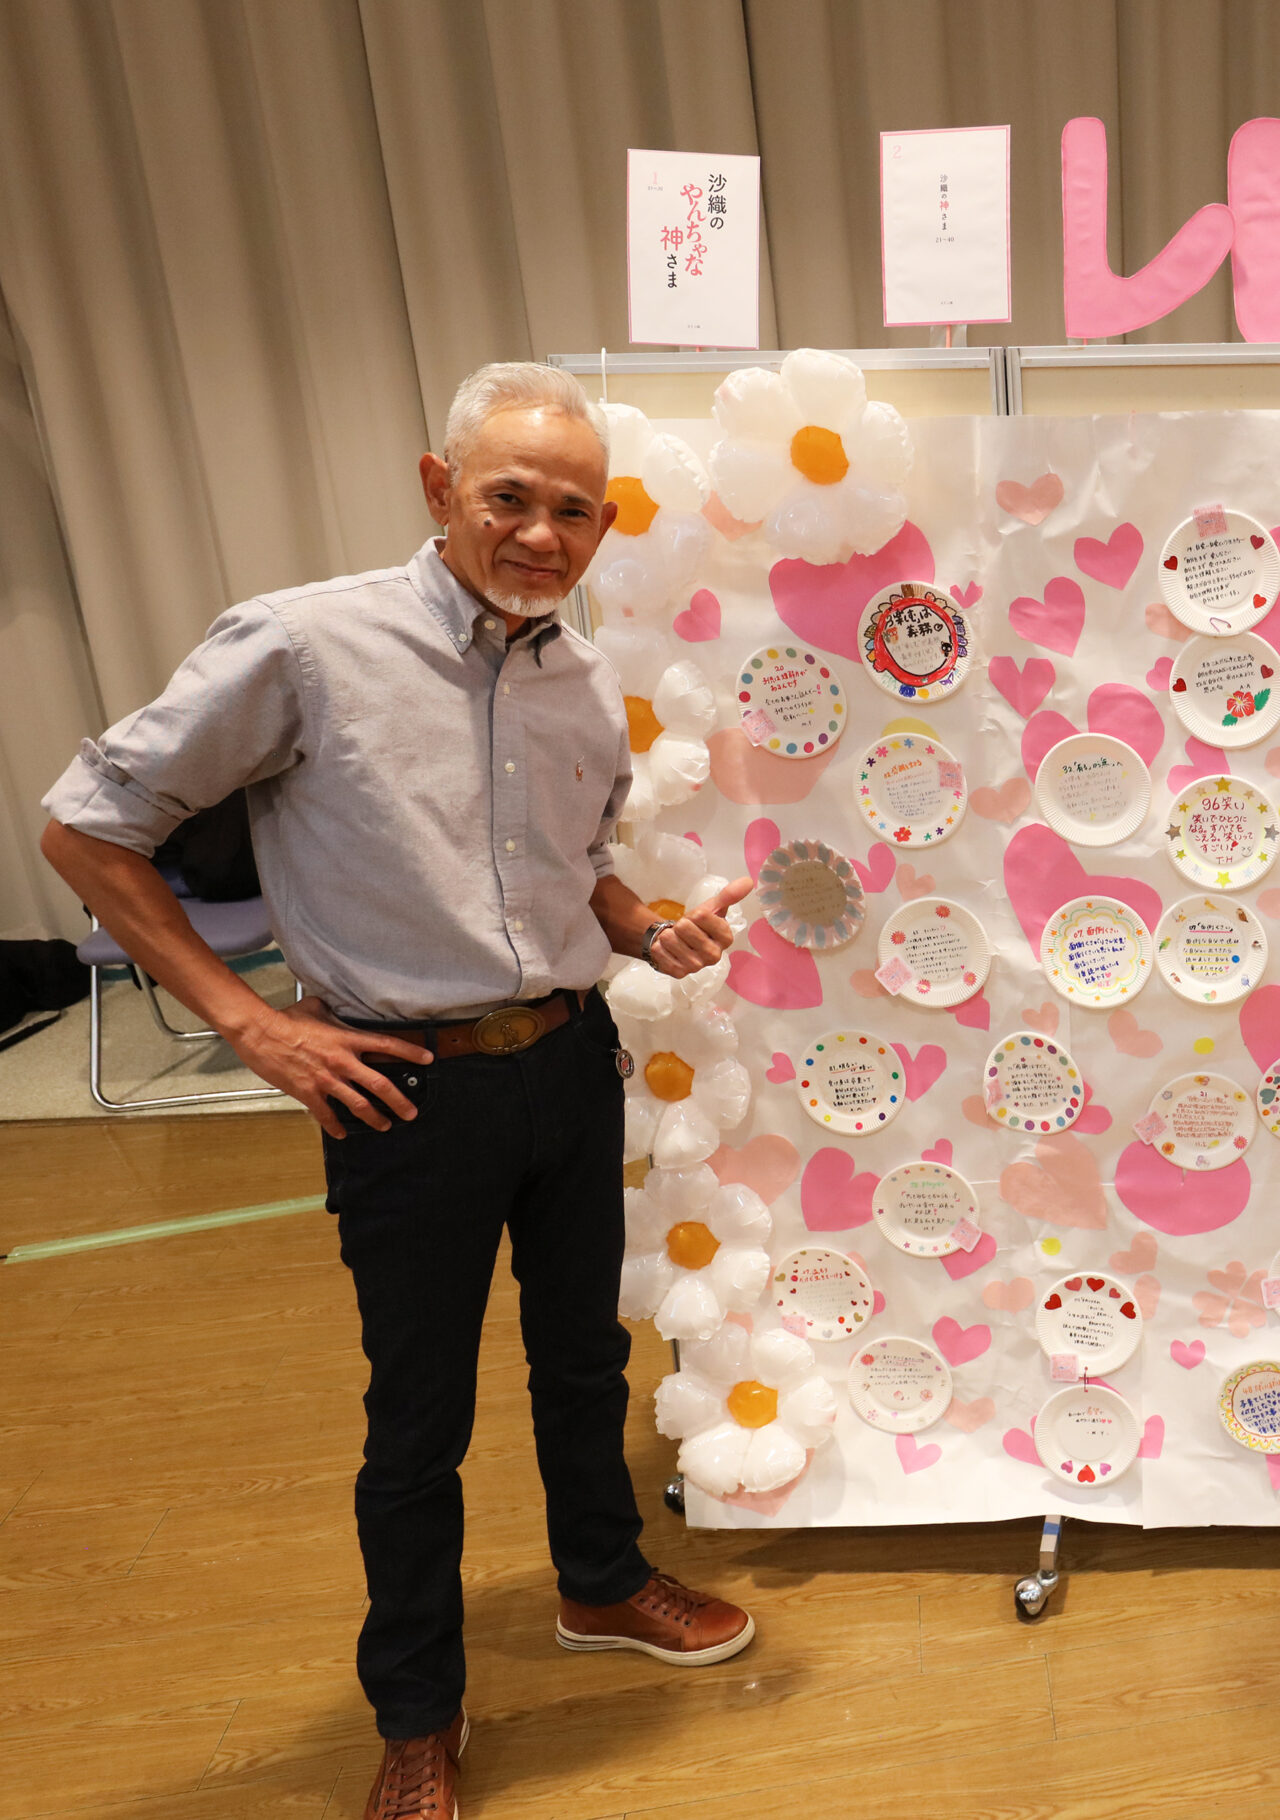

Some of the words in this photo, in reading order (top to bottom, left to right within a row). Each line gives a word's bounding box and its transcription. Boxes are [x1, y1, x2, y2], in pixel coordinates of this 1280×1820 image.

[679, 183, 708, 276] やんちゃな
[708, 173, 728, 230] 沙織の
[660, 226, 684, 288] 神さま
